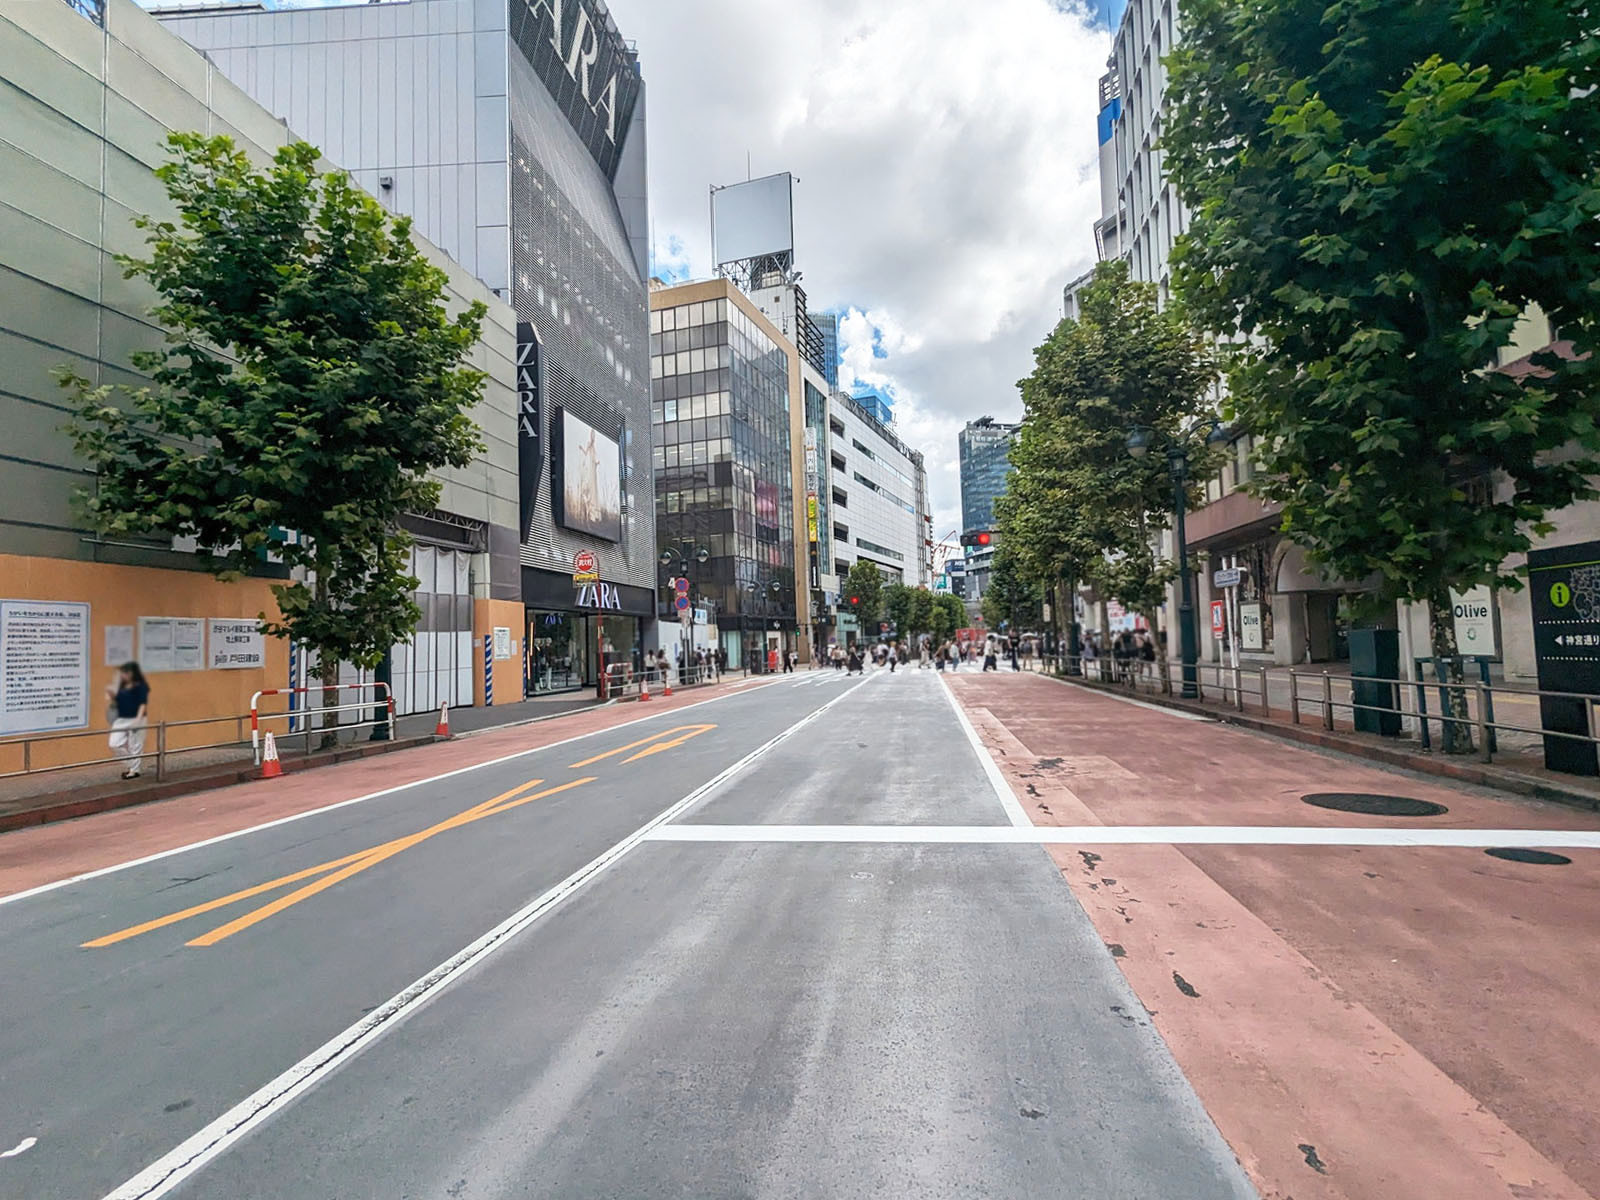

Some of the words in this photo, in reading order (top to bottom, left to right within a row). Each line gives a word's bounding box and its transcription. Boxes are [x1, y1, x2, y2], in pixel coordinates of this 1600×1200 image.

[516, 342, 538, 437] ZARA
[576, 583, 622, 610] ZARA
[1454, 604, 1487, 618] Olive
[1243, 615, 1259, 625] Olive
[1566, 634, 1600, 646] 神宮通り
